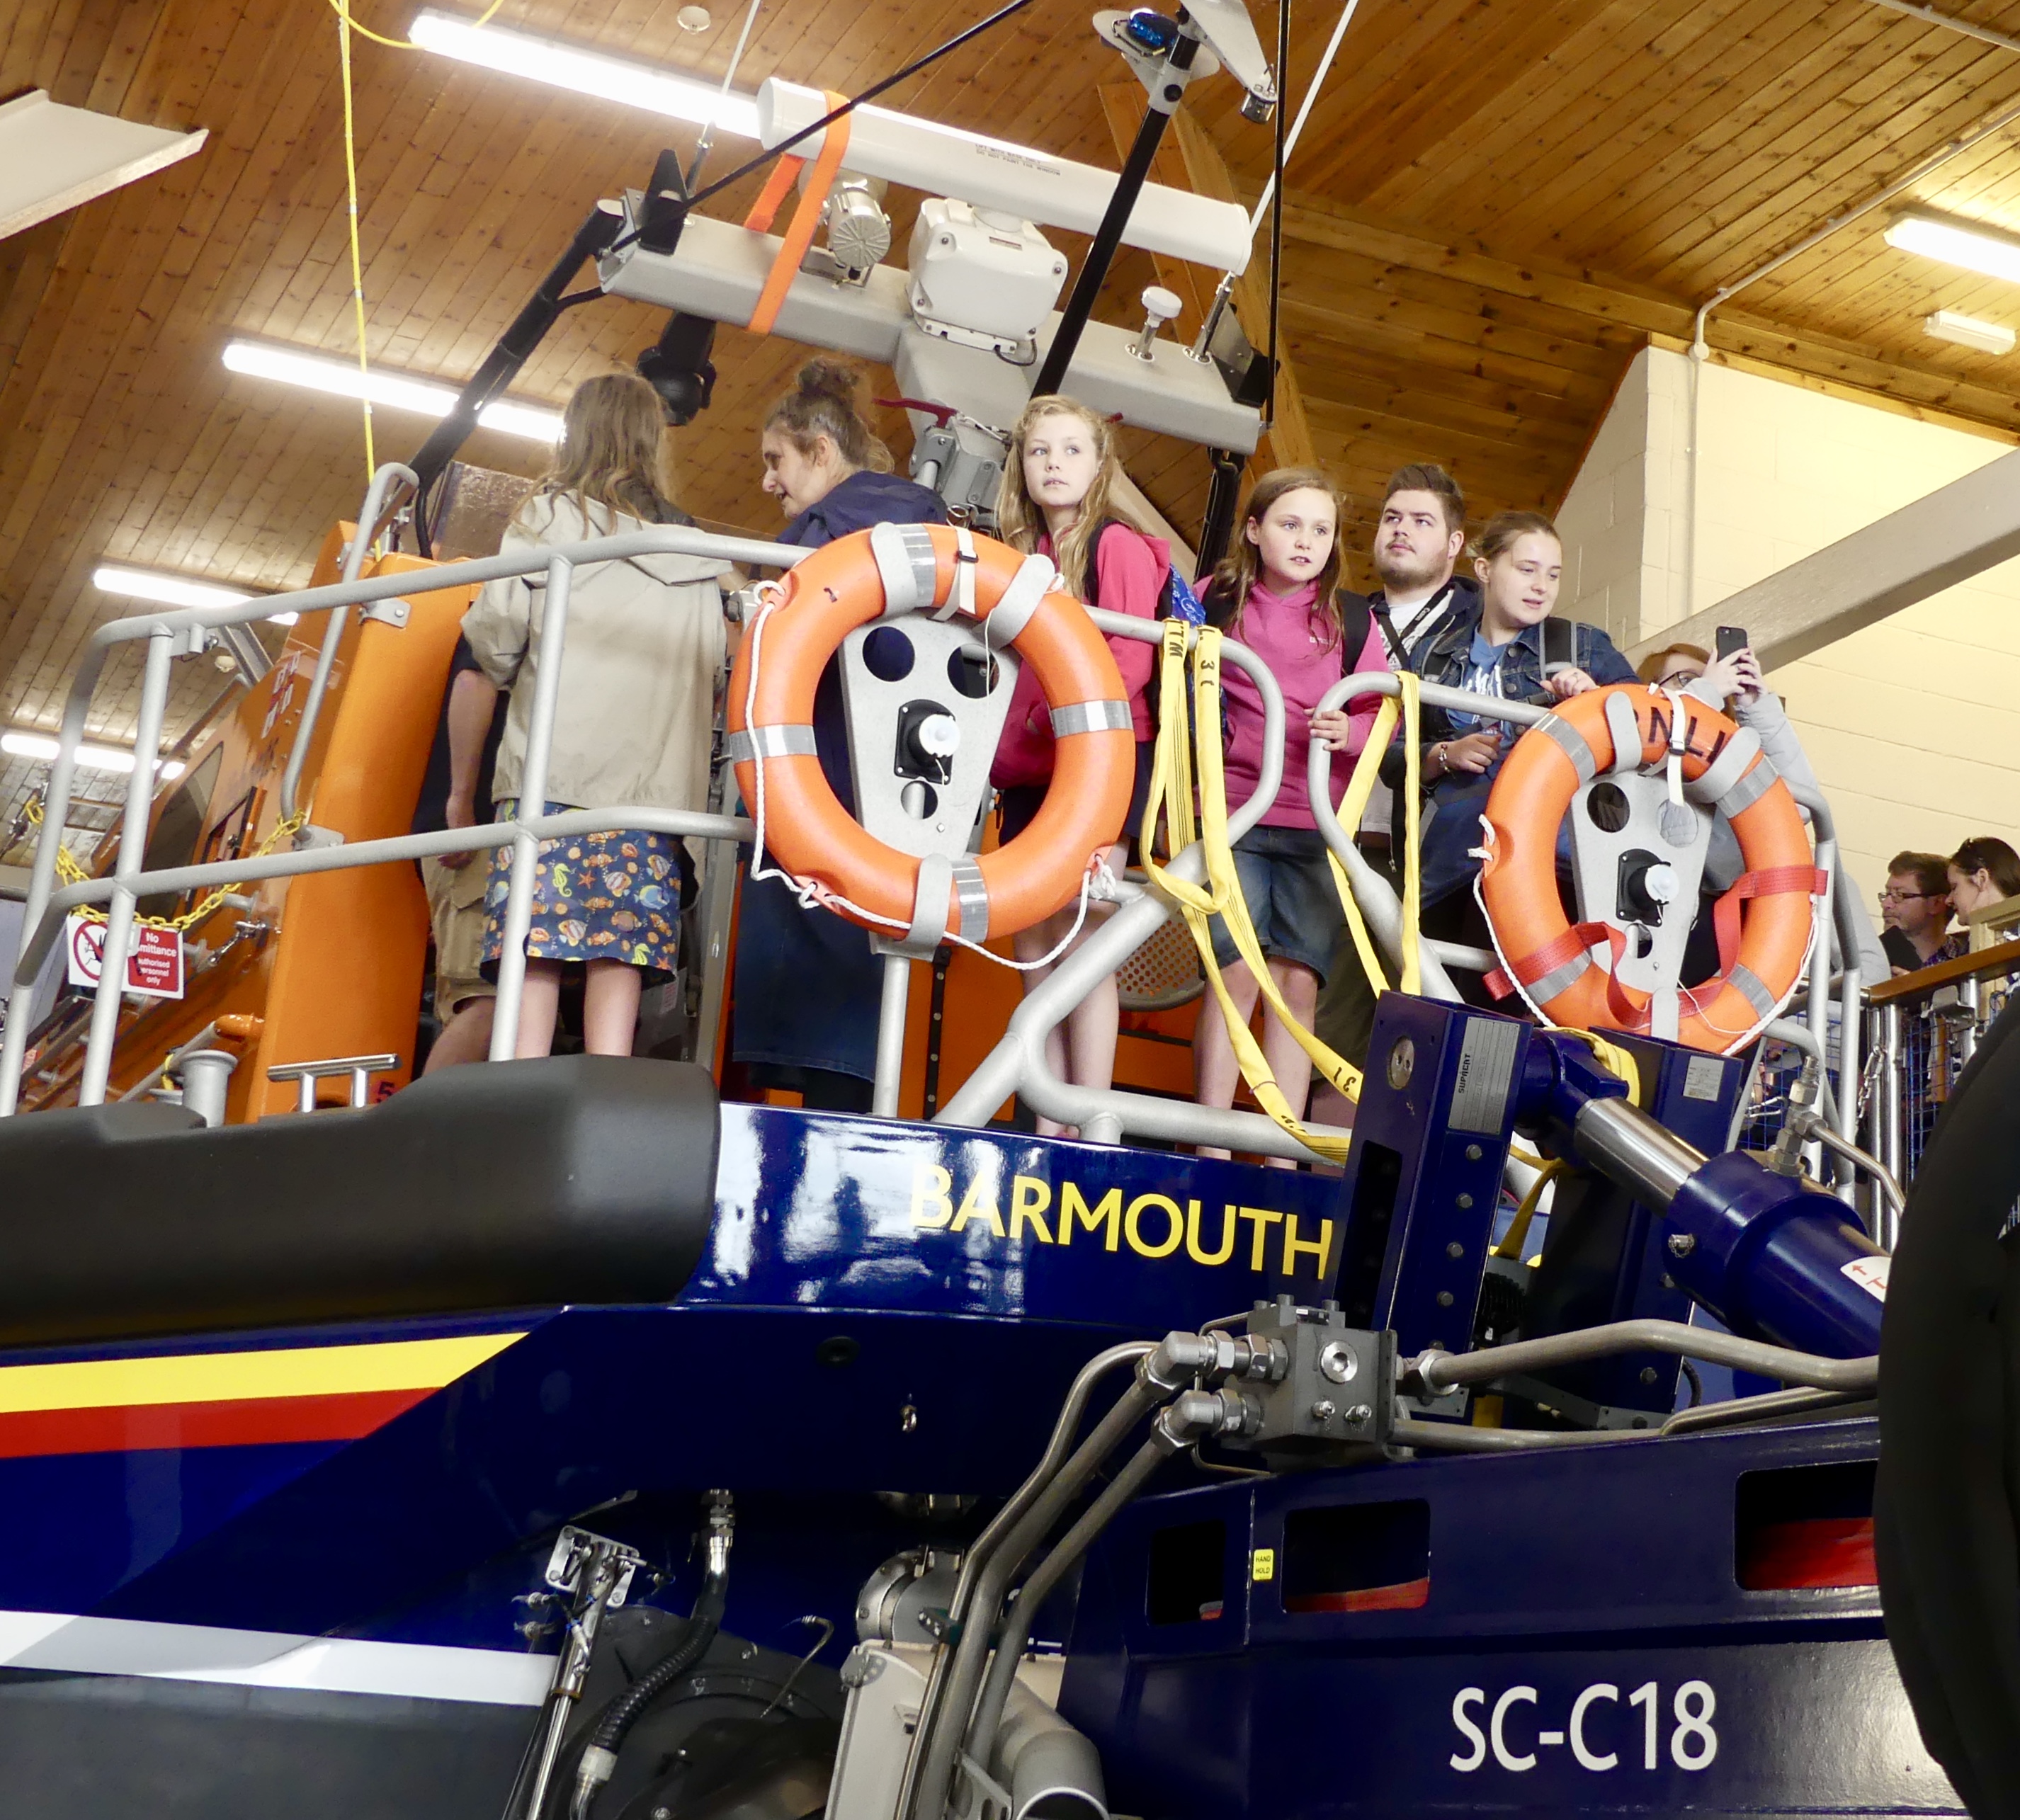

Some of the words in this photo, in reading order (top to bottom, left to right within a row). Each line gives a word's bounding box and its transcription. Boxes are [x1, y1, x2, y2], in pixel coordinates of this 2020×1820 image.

[1633, 706, 1726, 763] NLI
[146, 932, 159, 943] No
[139, 944, 177, 957] mittance
[140, 967, 169, 977] ersonnel
[146, 976, 161, 986] only
[909, 1164, 1333, 1280] BARMOUTH
[1449, 1680, 1718, 1772] SC-C18
